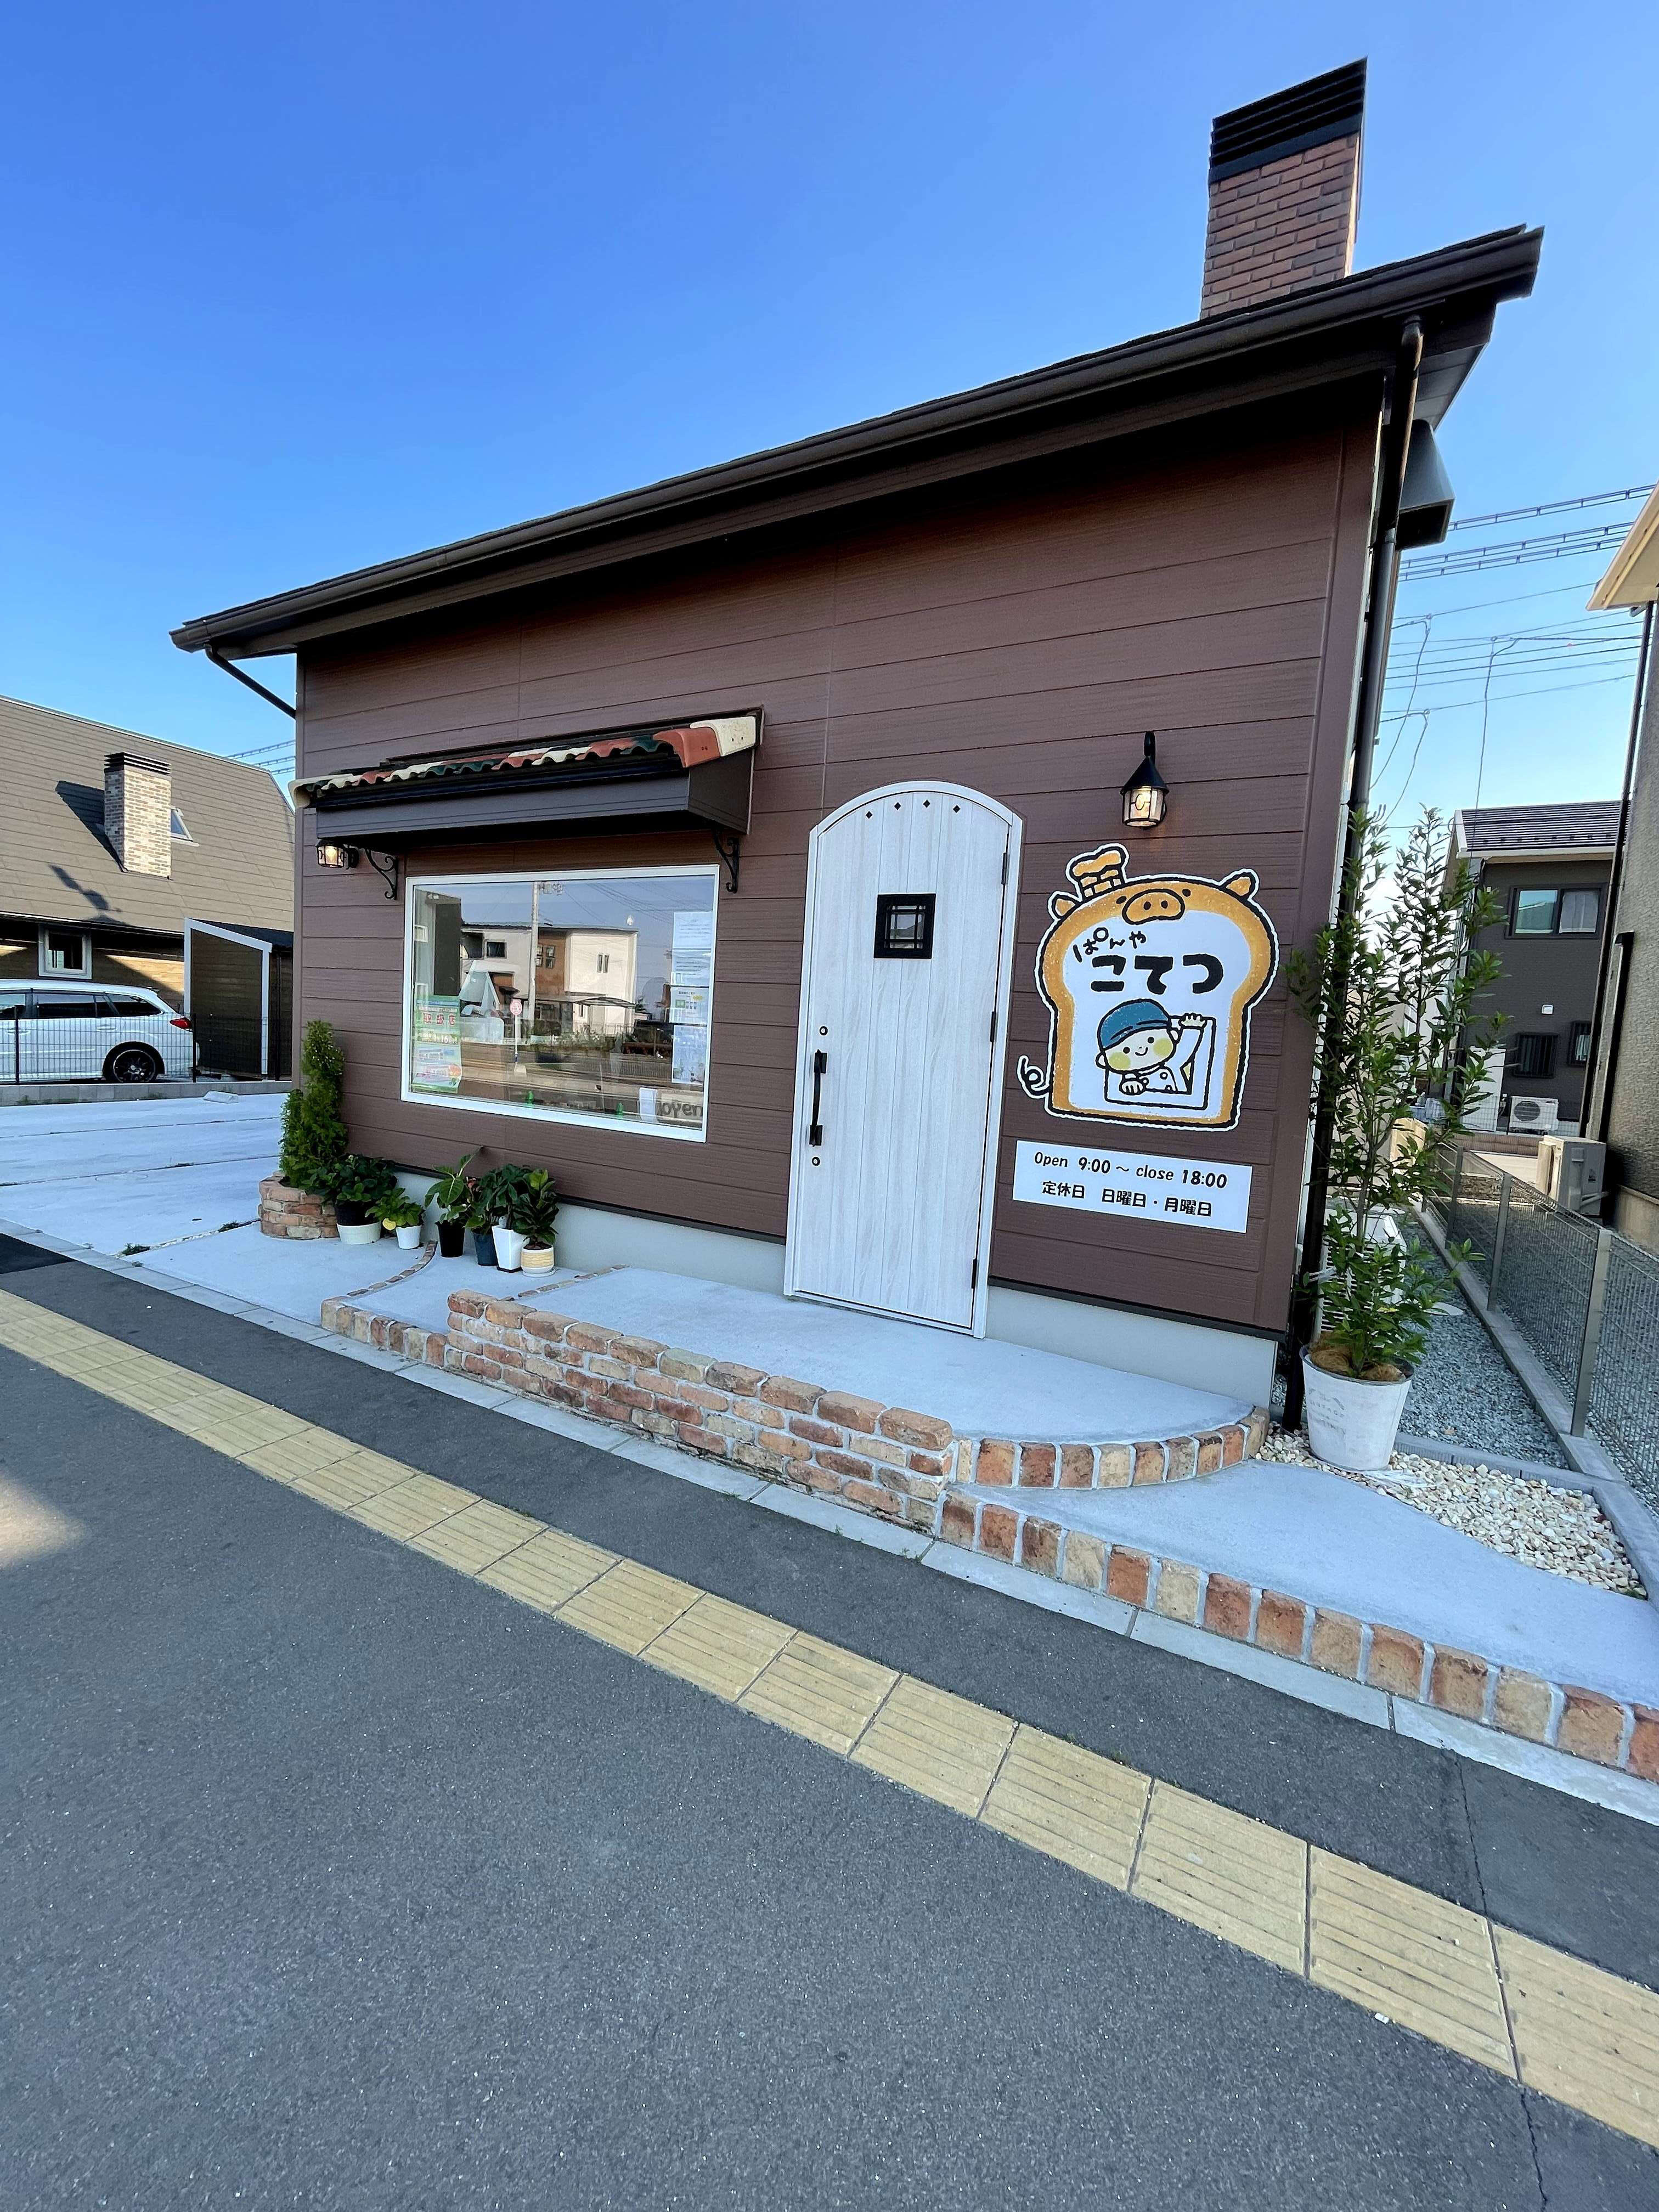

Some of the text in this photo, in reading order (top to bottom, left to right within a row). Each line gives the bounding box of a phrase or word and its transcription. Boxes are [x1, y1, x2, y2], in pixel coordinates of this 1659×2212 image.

[1073, 927, 1147, 963] ぱんや
[1091, 953, 1224, 995] こてつ
[1034, 1152, 1068, 1168] Open
[1078, 1156, 1111, 1174] 9:00
[1136, 1165, 1175, 1181] close
[1182, 1169, 1228, 1189] 18:00
[1042, 1180, 1085, 1199] 定休日
